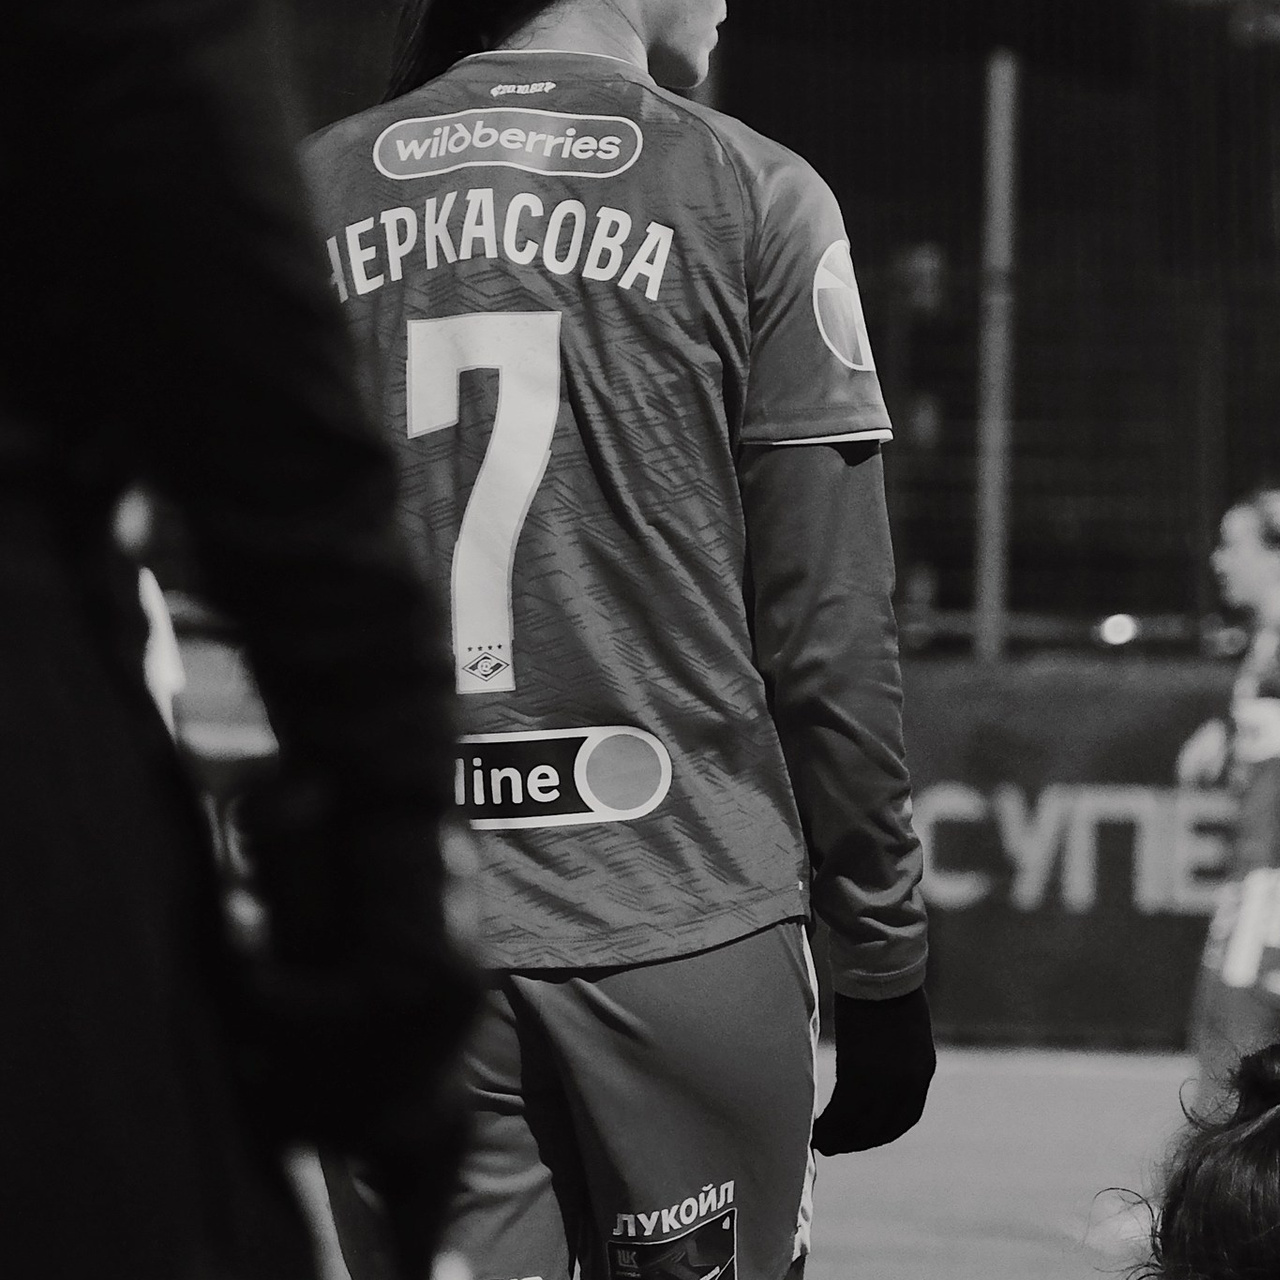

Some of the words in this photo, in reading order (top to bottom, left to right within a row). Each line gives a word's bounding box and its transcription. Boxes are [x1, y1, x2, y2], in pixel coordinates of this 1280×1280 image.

[395, 121, 622, 161] wildberries
[407, 311, 562, 694] 7
[454, 757, 561, 806] line
[613, 1180, 735, 1237] ЛУКОЙЛ
